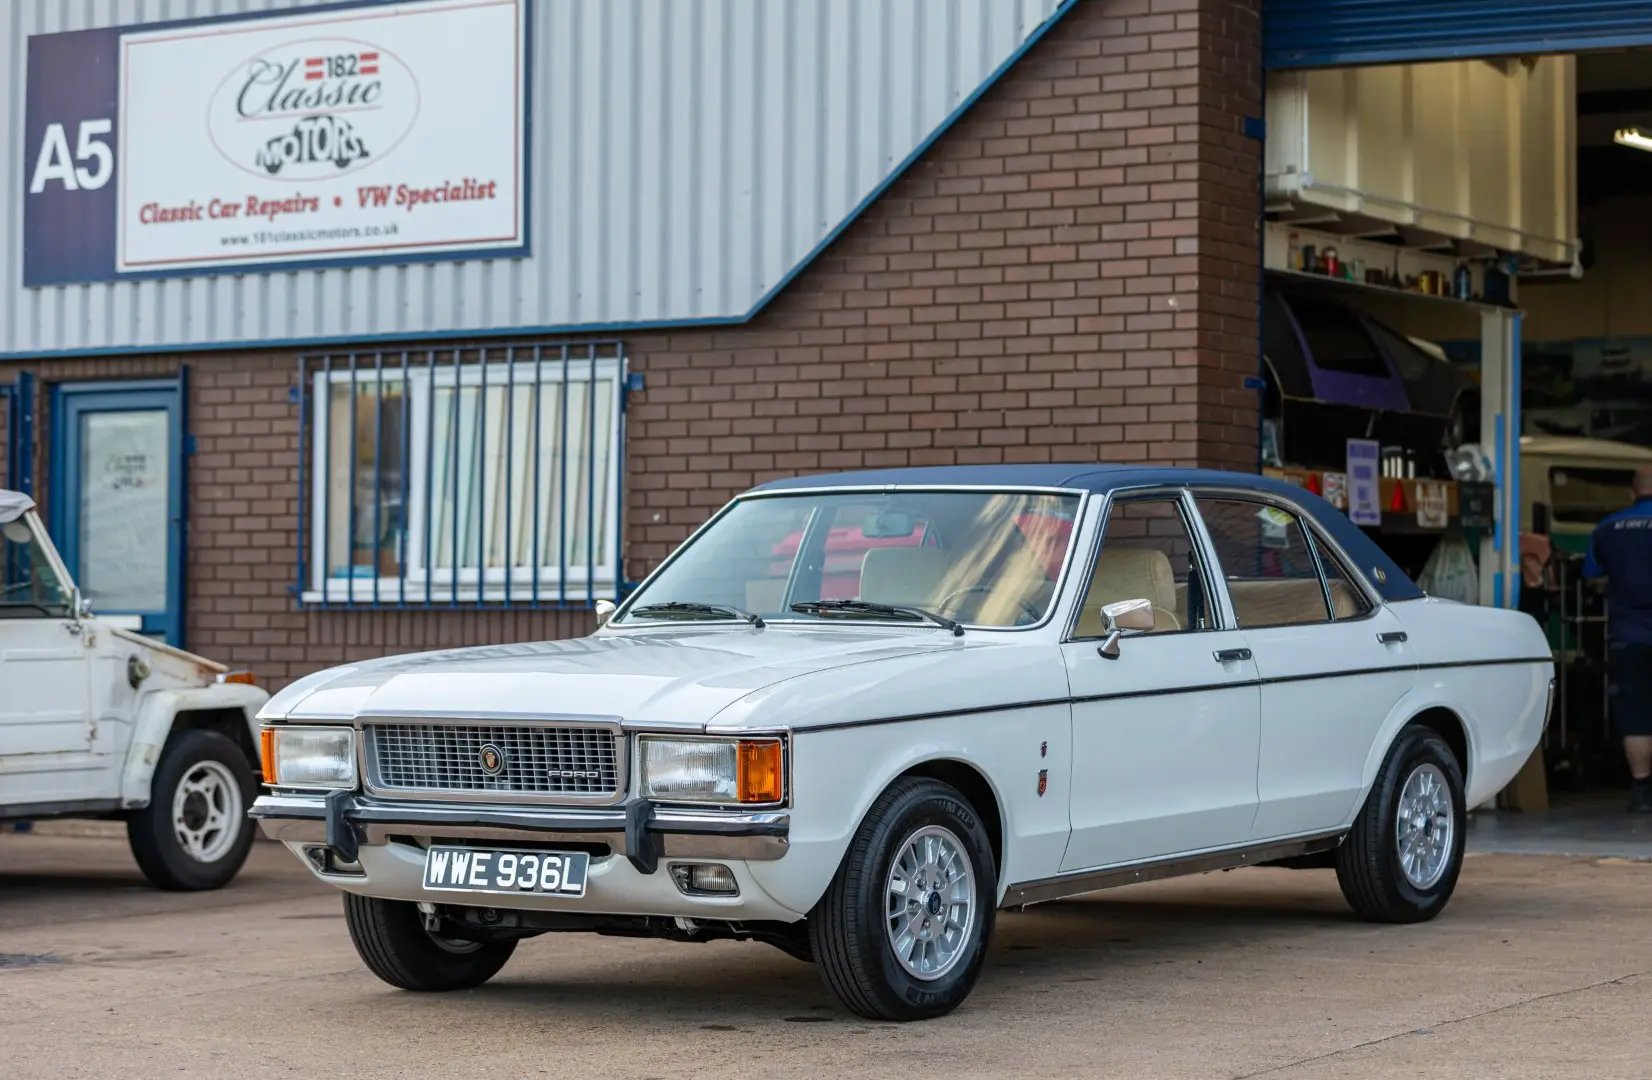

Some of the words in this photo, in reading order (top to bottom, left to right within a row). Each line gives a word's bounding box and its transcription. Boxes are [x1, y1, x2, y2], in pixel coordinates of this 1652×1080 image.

[236, 57, 383, 118] Classic
[325, 54, 360, 79] 182
[30, 118, 114, 194] A5
[139, 199, 203, 225] Classic
[208, 197, 242, 219] Car
[245, 191, 320, 223] Repairs
[356, 184, 393, 209] VW
[394, 176, 497, 212] Specialist
[548, 770, 599, 779] FORD
[430, 851, 492, 886] WWE
[496, 854, 582, 891] 936L
